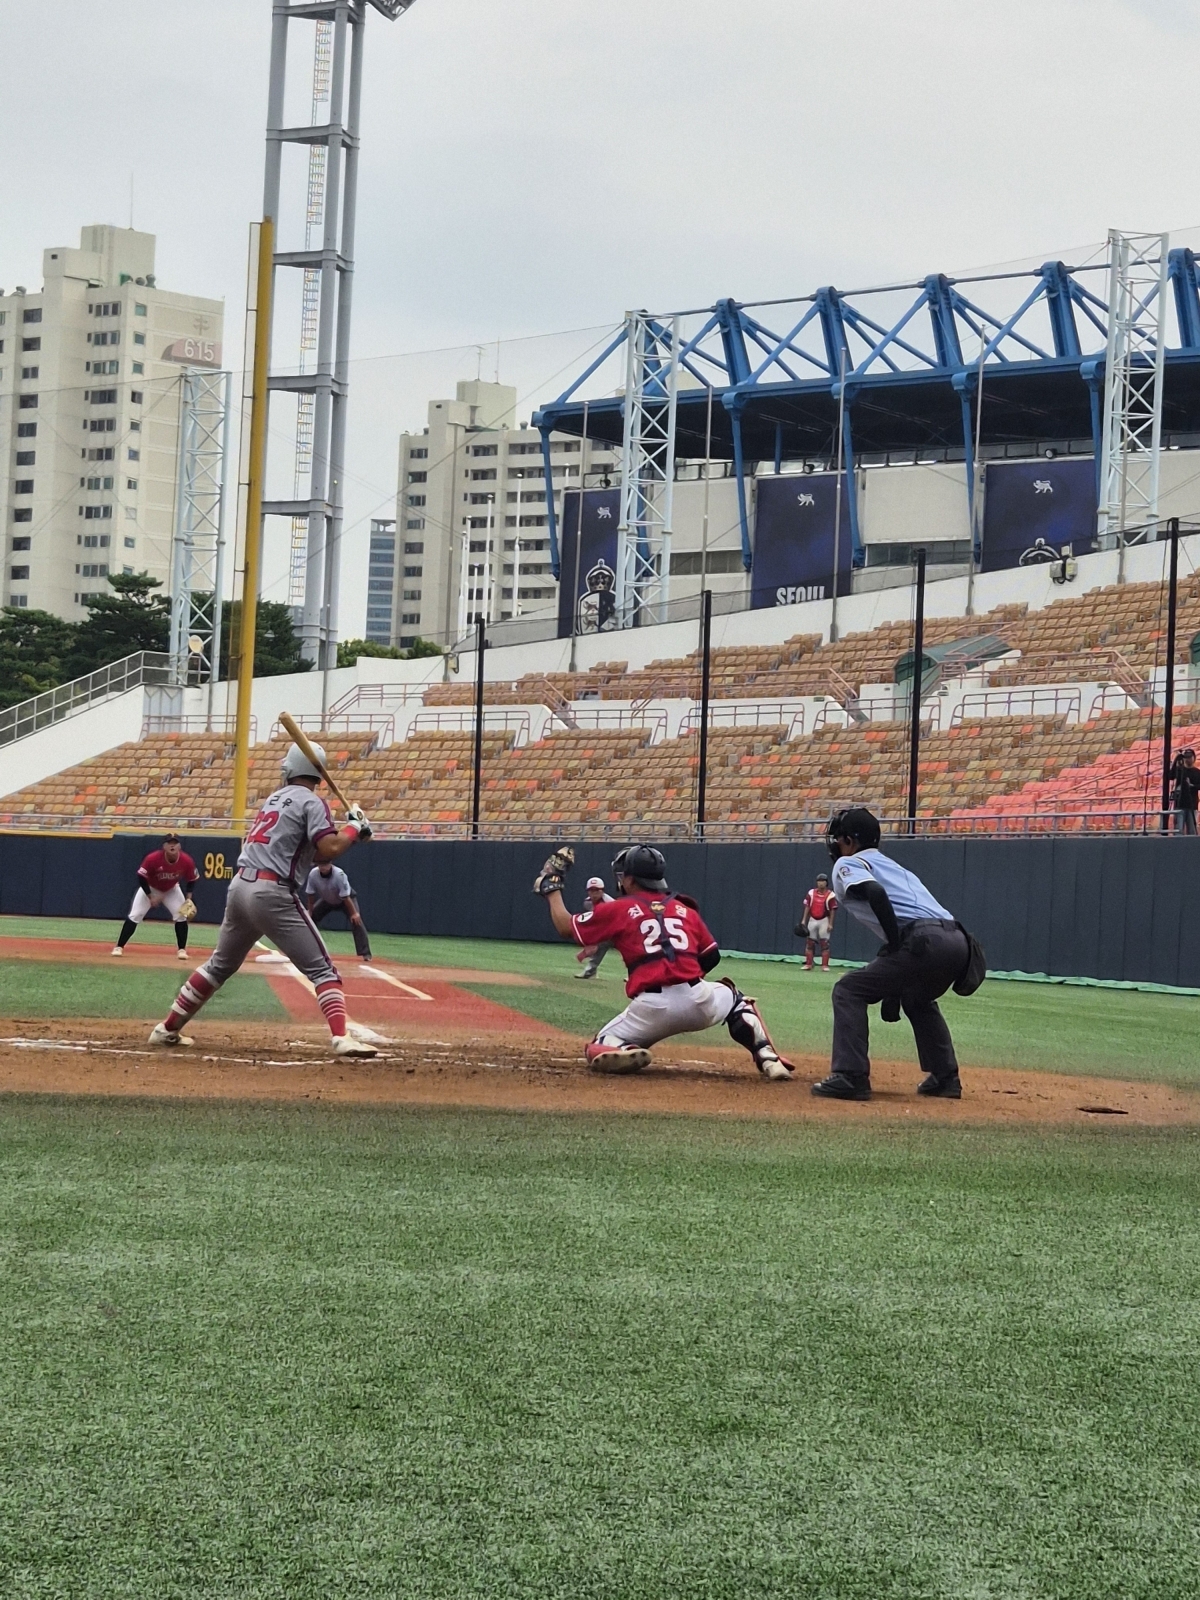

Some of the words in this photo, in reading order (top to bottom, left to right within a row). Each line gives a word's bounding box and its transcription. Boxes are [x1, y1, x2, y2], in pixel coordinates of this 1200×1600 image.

[184, 338, 215, 362] 615
[204, 852, 233, 879] 98m
[640, 918, 689, 954] 25
